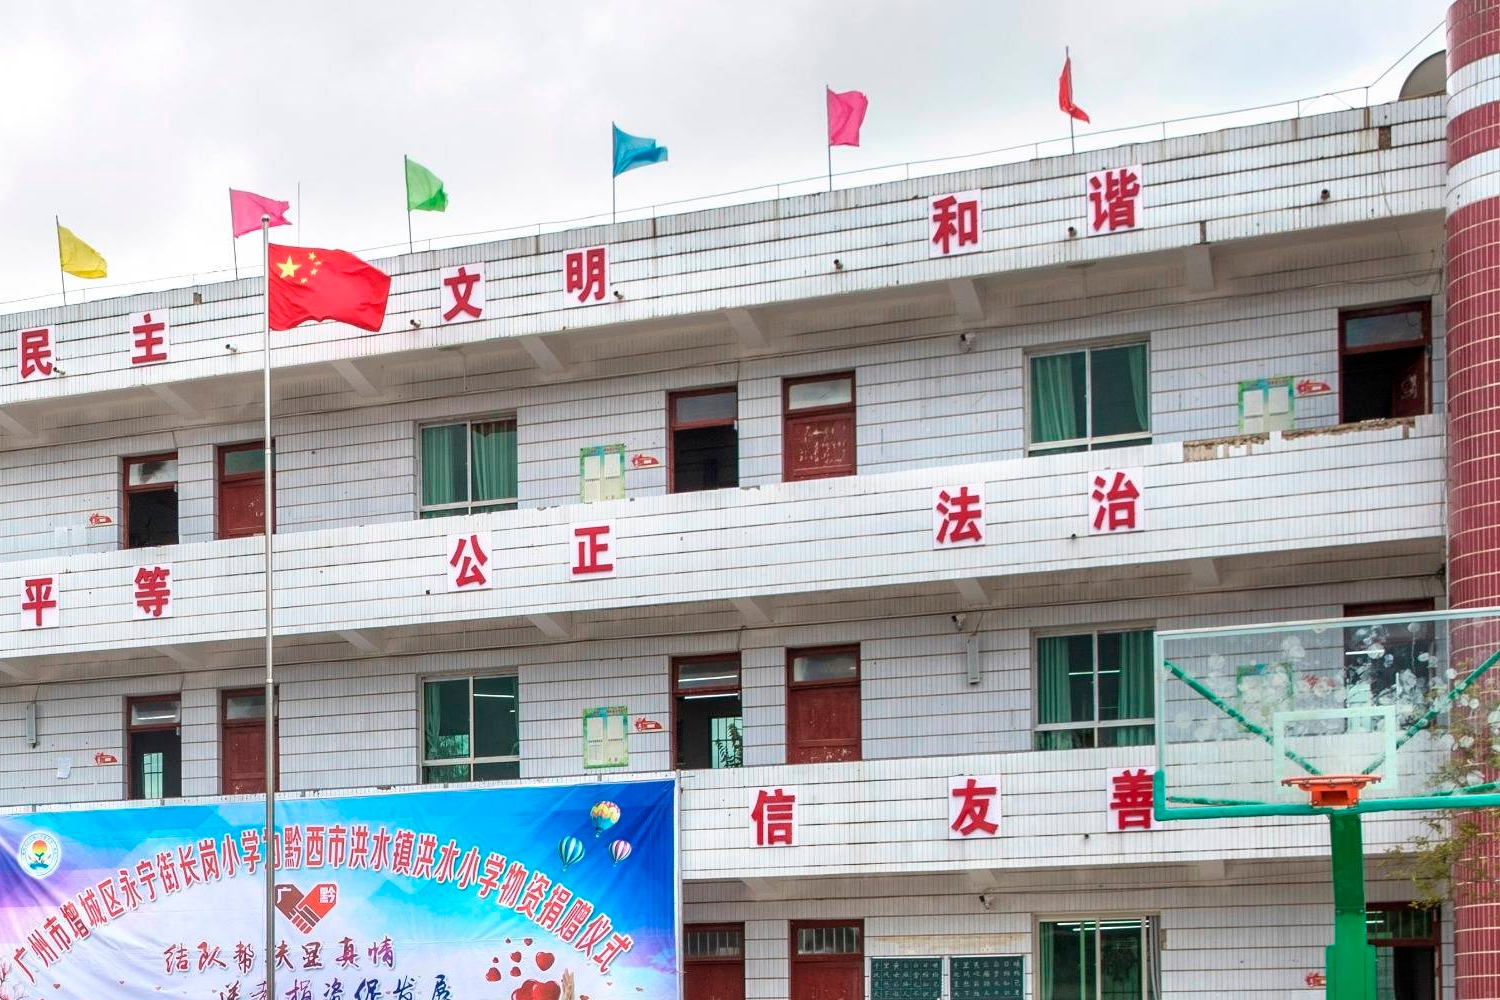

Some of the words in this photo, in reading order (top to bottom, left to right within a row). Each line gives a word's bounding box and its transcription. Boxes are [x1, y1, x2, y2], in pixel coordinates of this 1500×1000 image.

[21, 314, 167, 378] 民主
[443, 250, 605, 321] 文明
[932, 170, 1140, 253] 和谐
[22, 567, 171, 625] 平等
[451, 527, 614, 587] 公正
[936, 472, 1141, 542] 法治
[751, 788, 796, 846] 信
